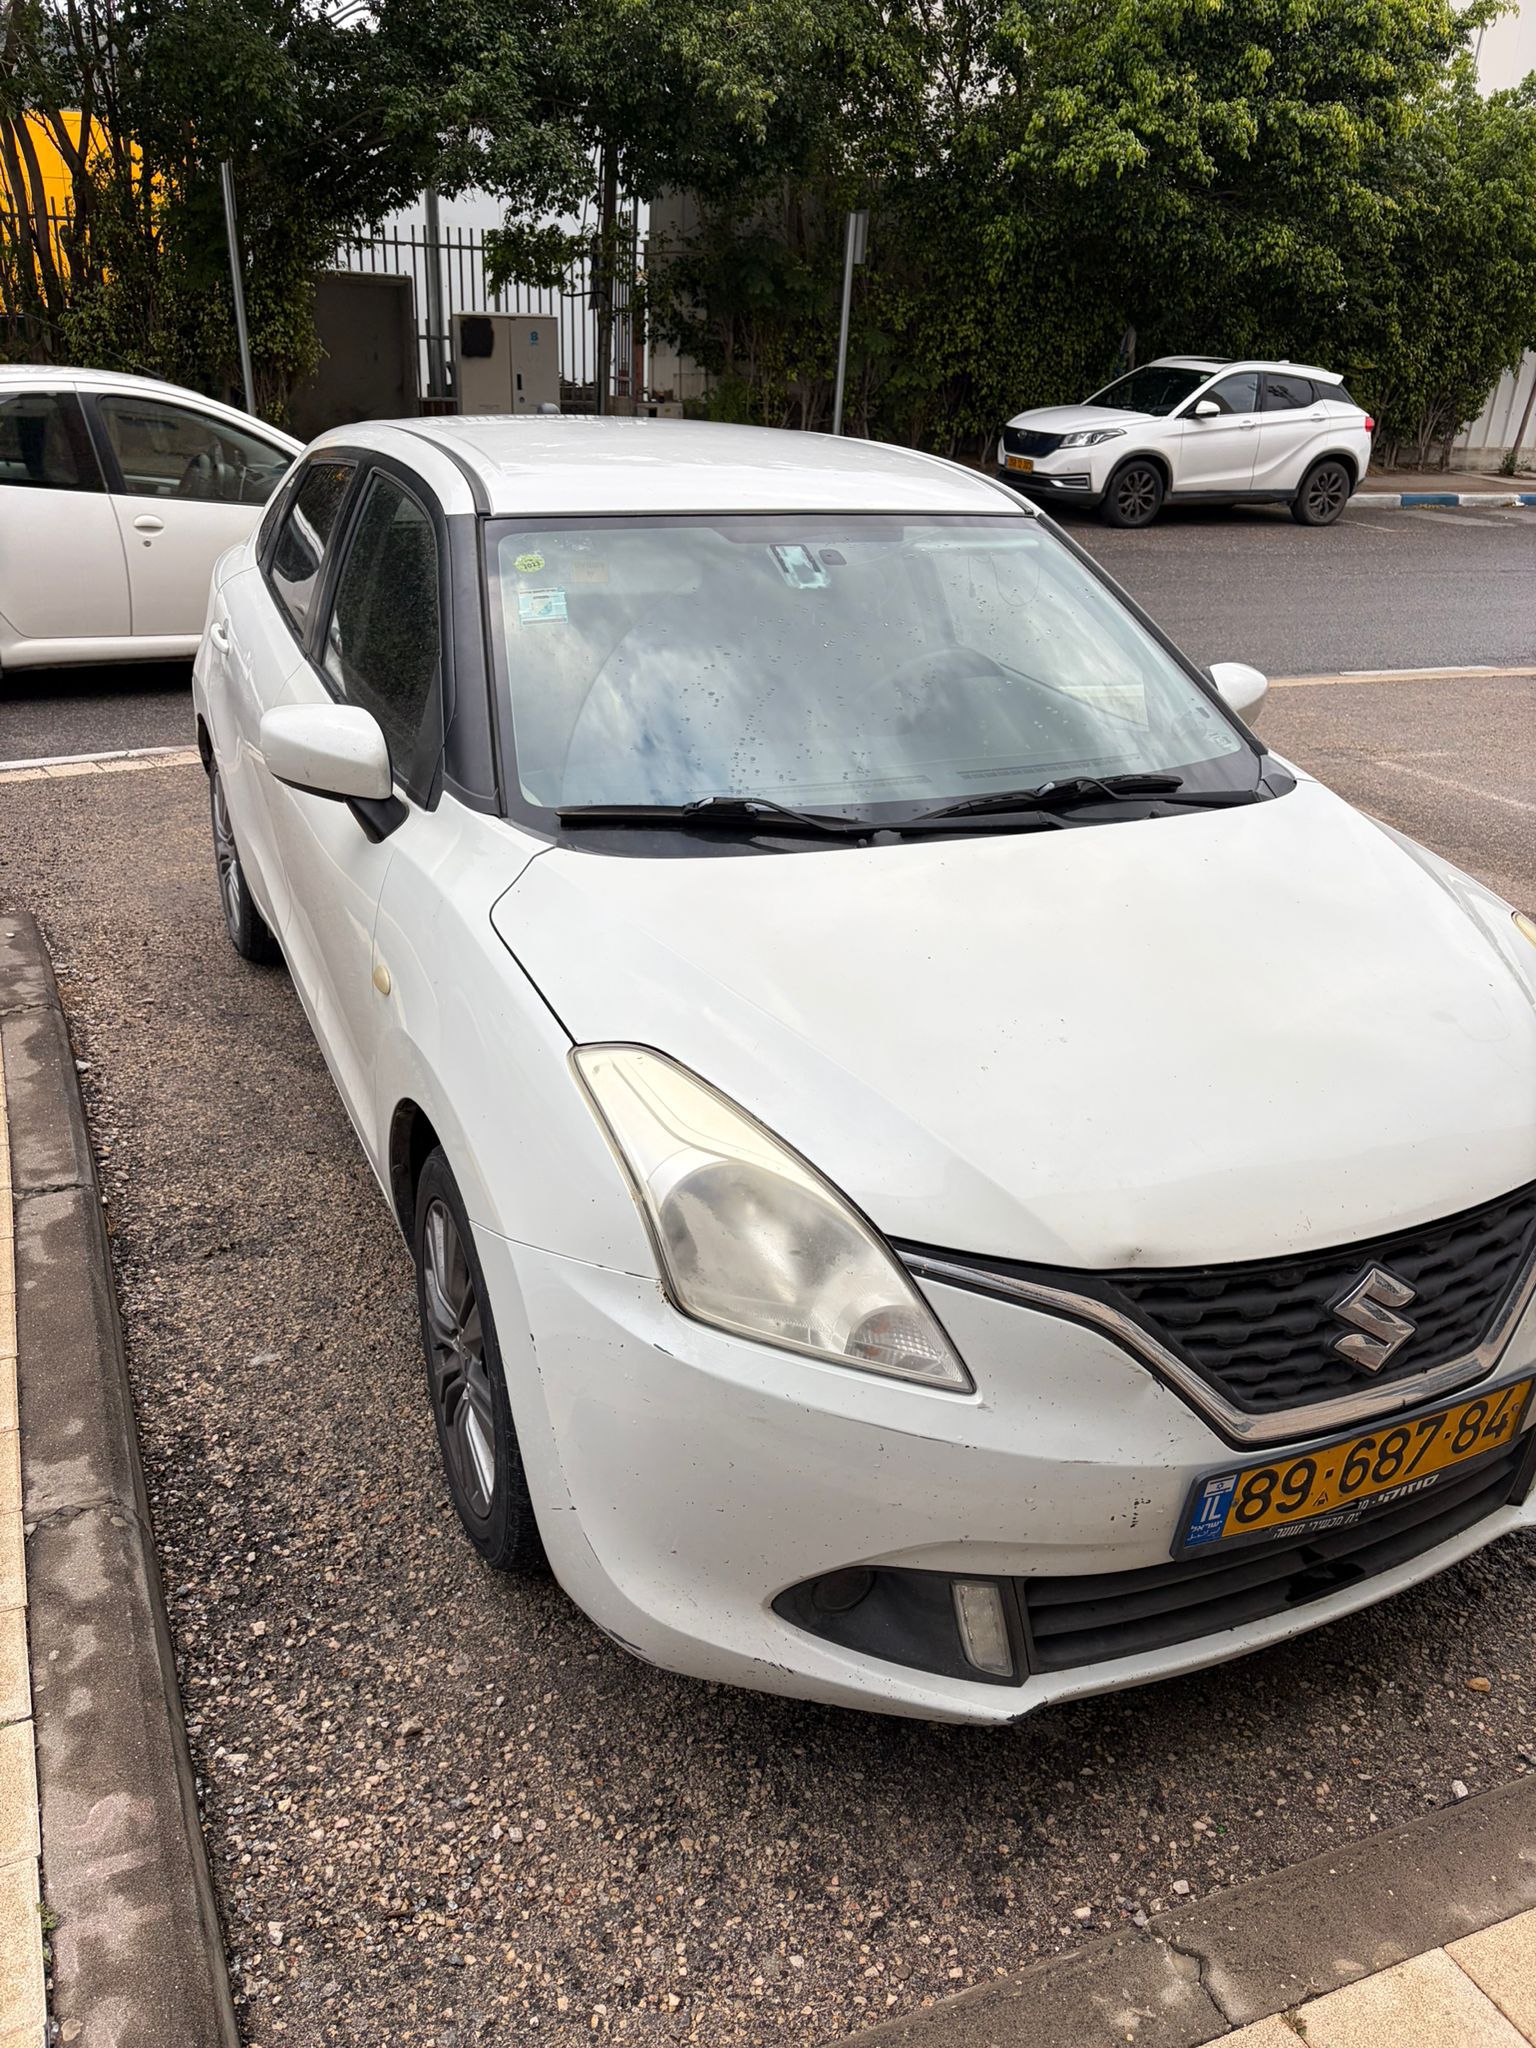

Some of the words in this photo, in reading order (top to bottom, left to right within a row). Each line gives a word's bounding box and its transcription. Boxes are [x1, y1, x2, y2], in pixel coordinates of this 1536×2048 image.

[1378, 1473, 1440, 1503] סוזוקי
[1200, 1495, 1221, 1522] IL
[1191, 1520, 1223, 1533] ישראל
